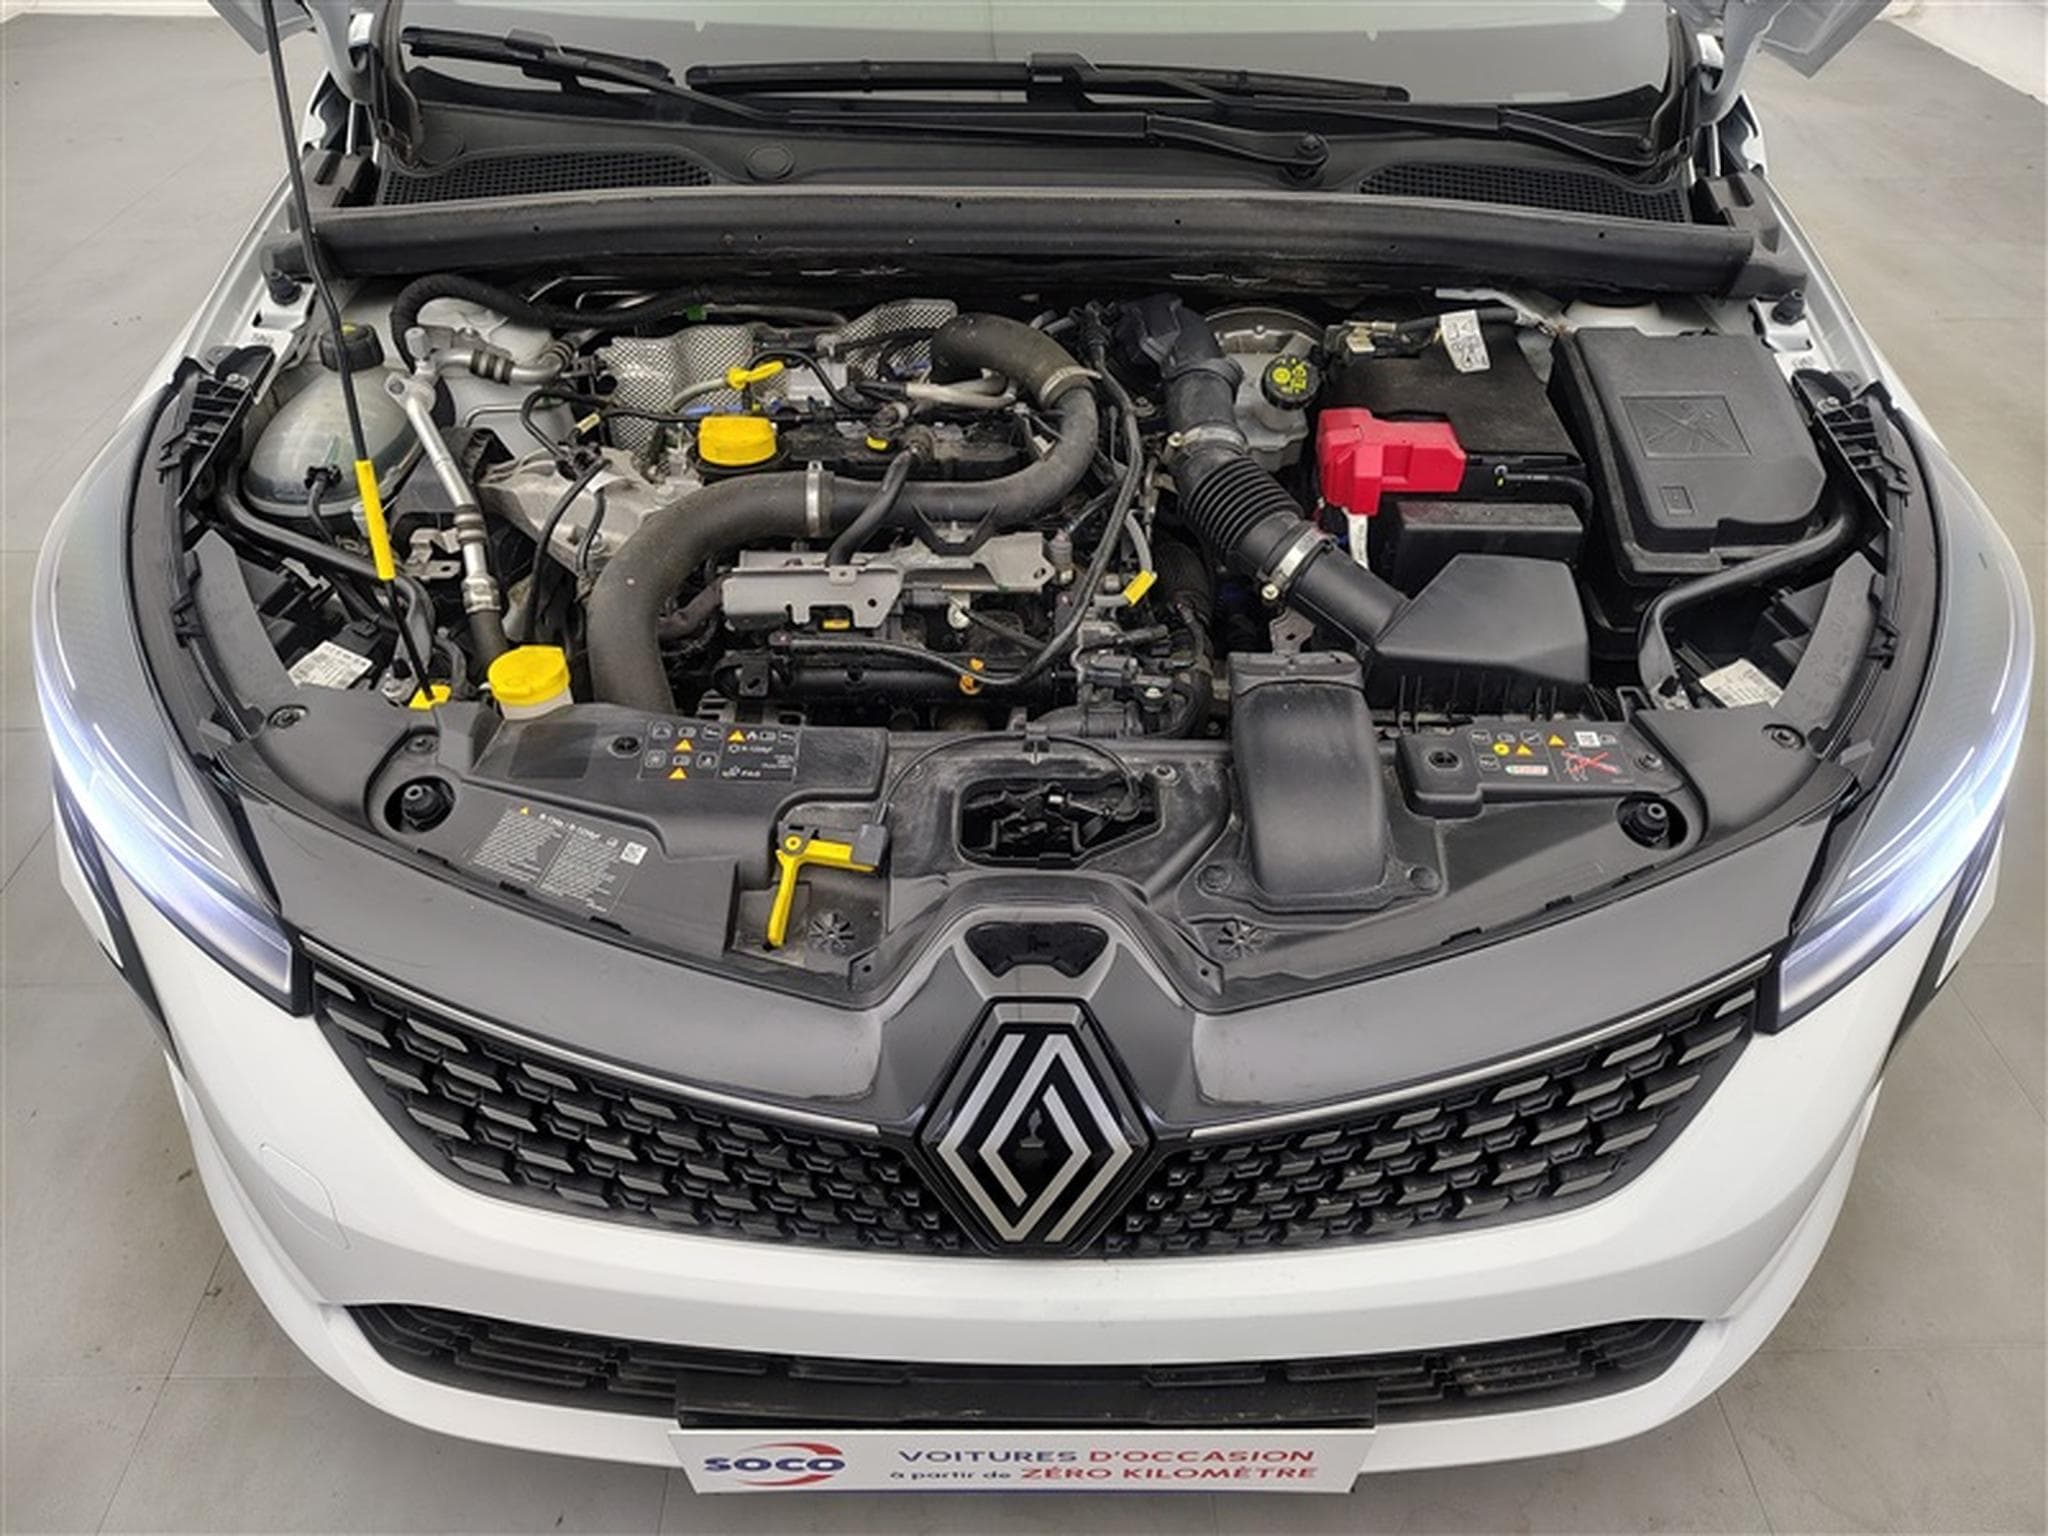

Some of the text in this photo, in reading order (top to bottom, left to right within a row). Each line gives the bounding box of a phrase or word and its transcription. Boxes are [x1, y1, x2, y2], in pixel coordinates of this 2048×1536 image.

[898, 1450, 1315, 1463] VOITURES D'OCCASION
[704, 1457, 846, 1472] SOCO
[911, 1468, 975, 1480] partir
[982, 1468, 1011, 1479] de
[1021, 1466, 1112, 1479] ZÉRO
[1122, 1466, 1318, 1479] KILOMÈTRE
